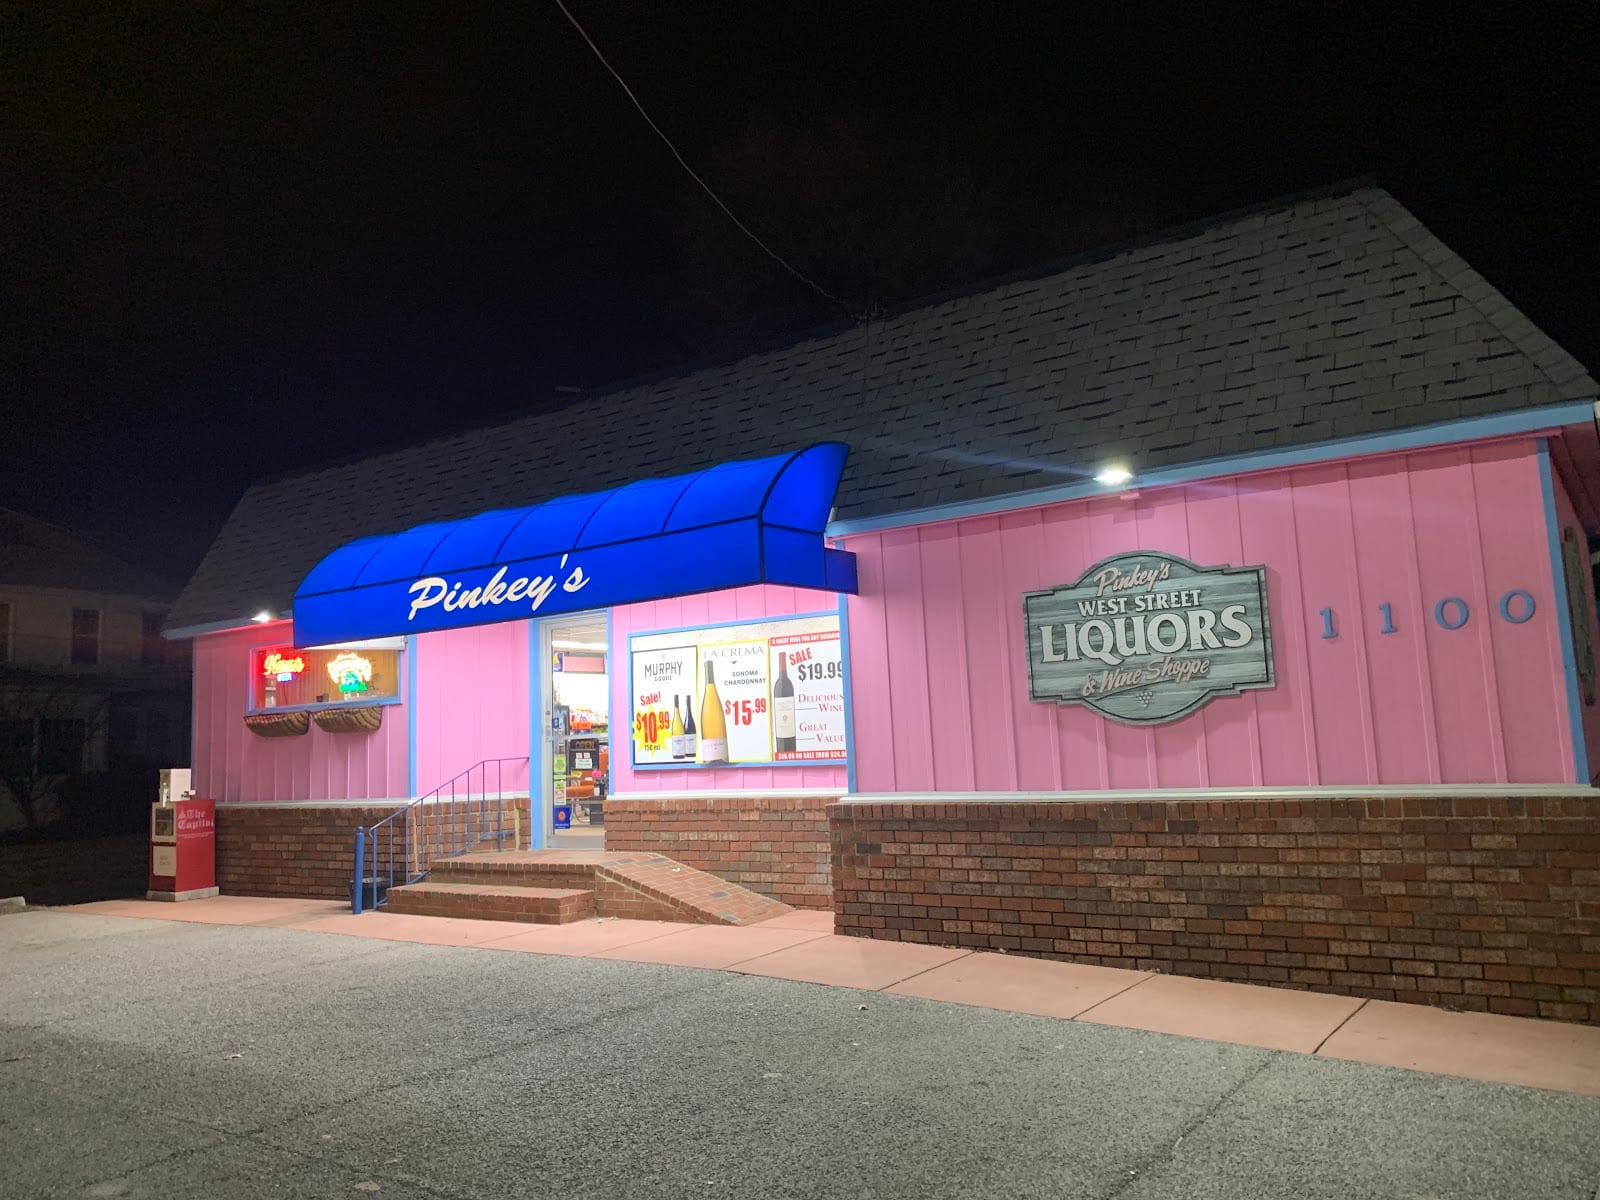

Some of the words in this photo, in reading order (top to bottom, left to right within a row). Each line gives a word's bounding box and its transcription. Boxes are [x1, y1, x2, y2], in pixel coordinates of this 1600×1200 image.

[408, 553, 590, 621] Pinkey's
[1094, 562, 1171, 597] Pinkey's
[1078, 597, 1128, 617] WEST
[1134, 589, 1201, 612] STREET
[1040, 605, 1253, 666] LIQUORS
[721, 645, 764, 657] CREMA
[789, 647, 813, 666] SALE
[644, 661, 683, 679] MURPHY
[732, 670, 759, 678] SONOMA
[1082, 674, 1096, 697] &
[1100, 667, 1143, 692] Wine
[1146, 656, 1210, 683] Shoppe
[724, 678, 766, 686] CHARDONNAY
[640, 691, 661, 706] Sale!
[725, 698, 766, 726] $15.99
[636, 711, 670, 743] $10.99
[799, 722, 827, 732] GREAT
